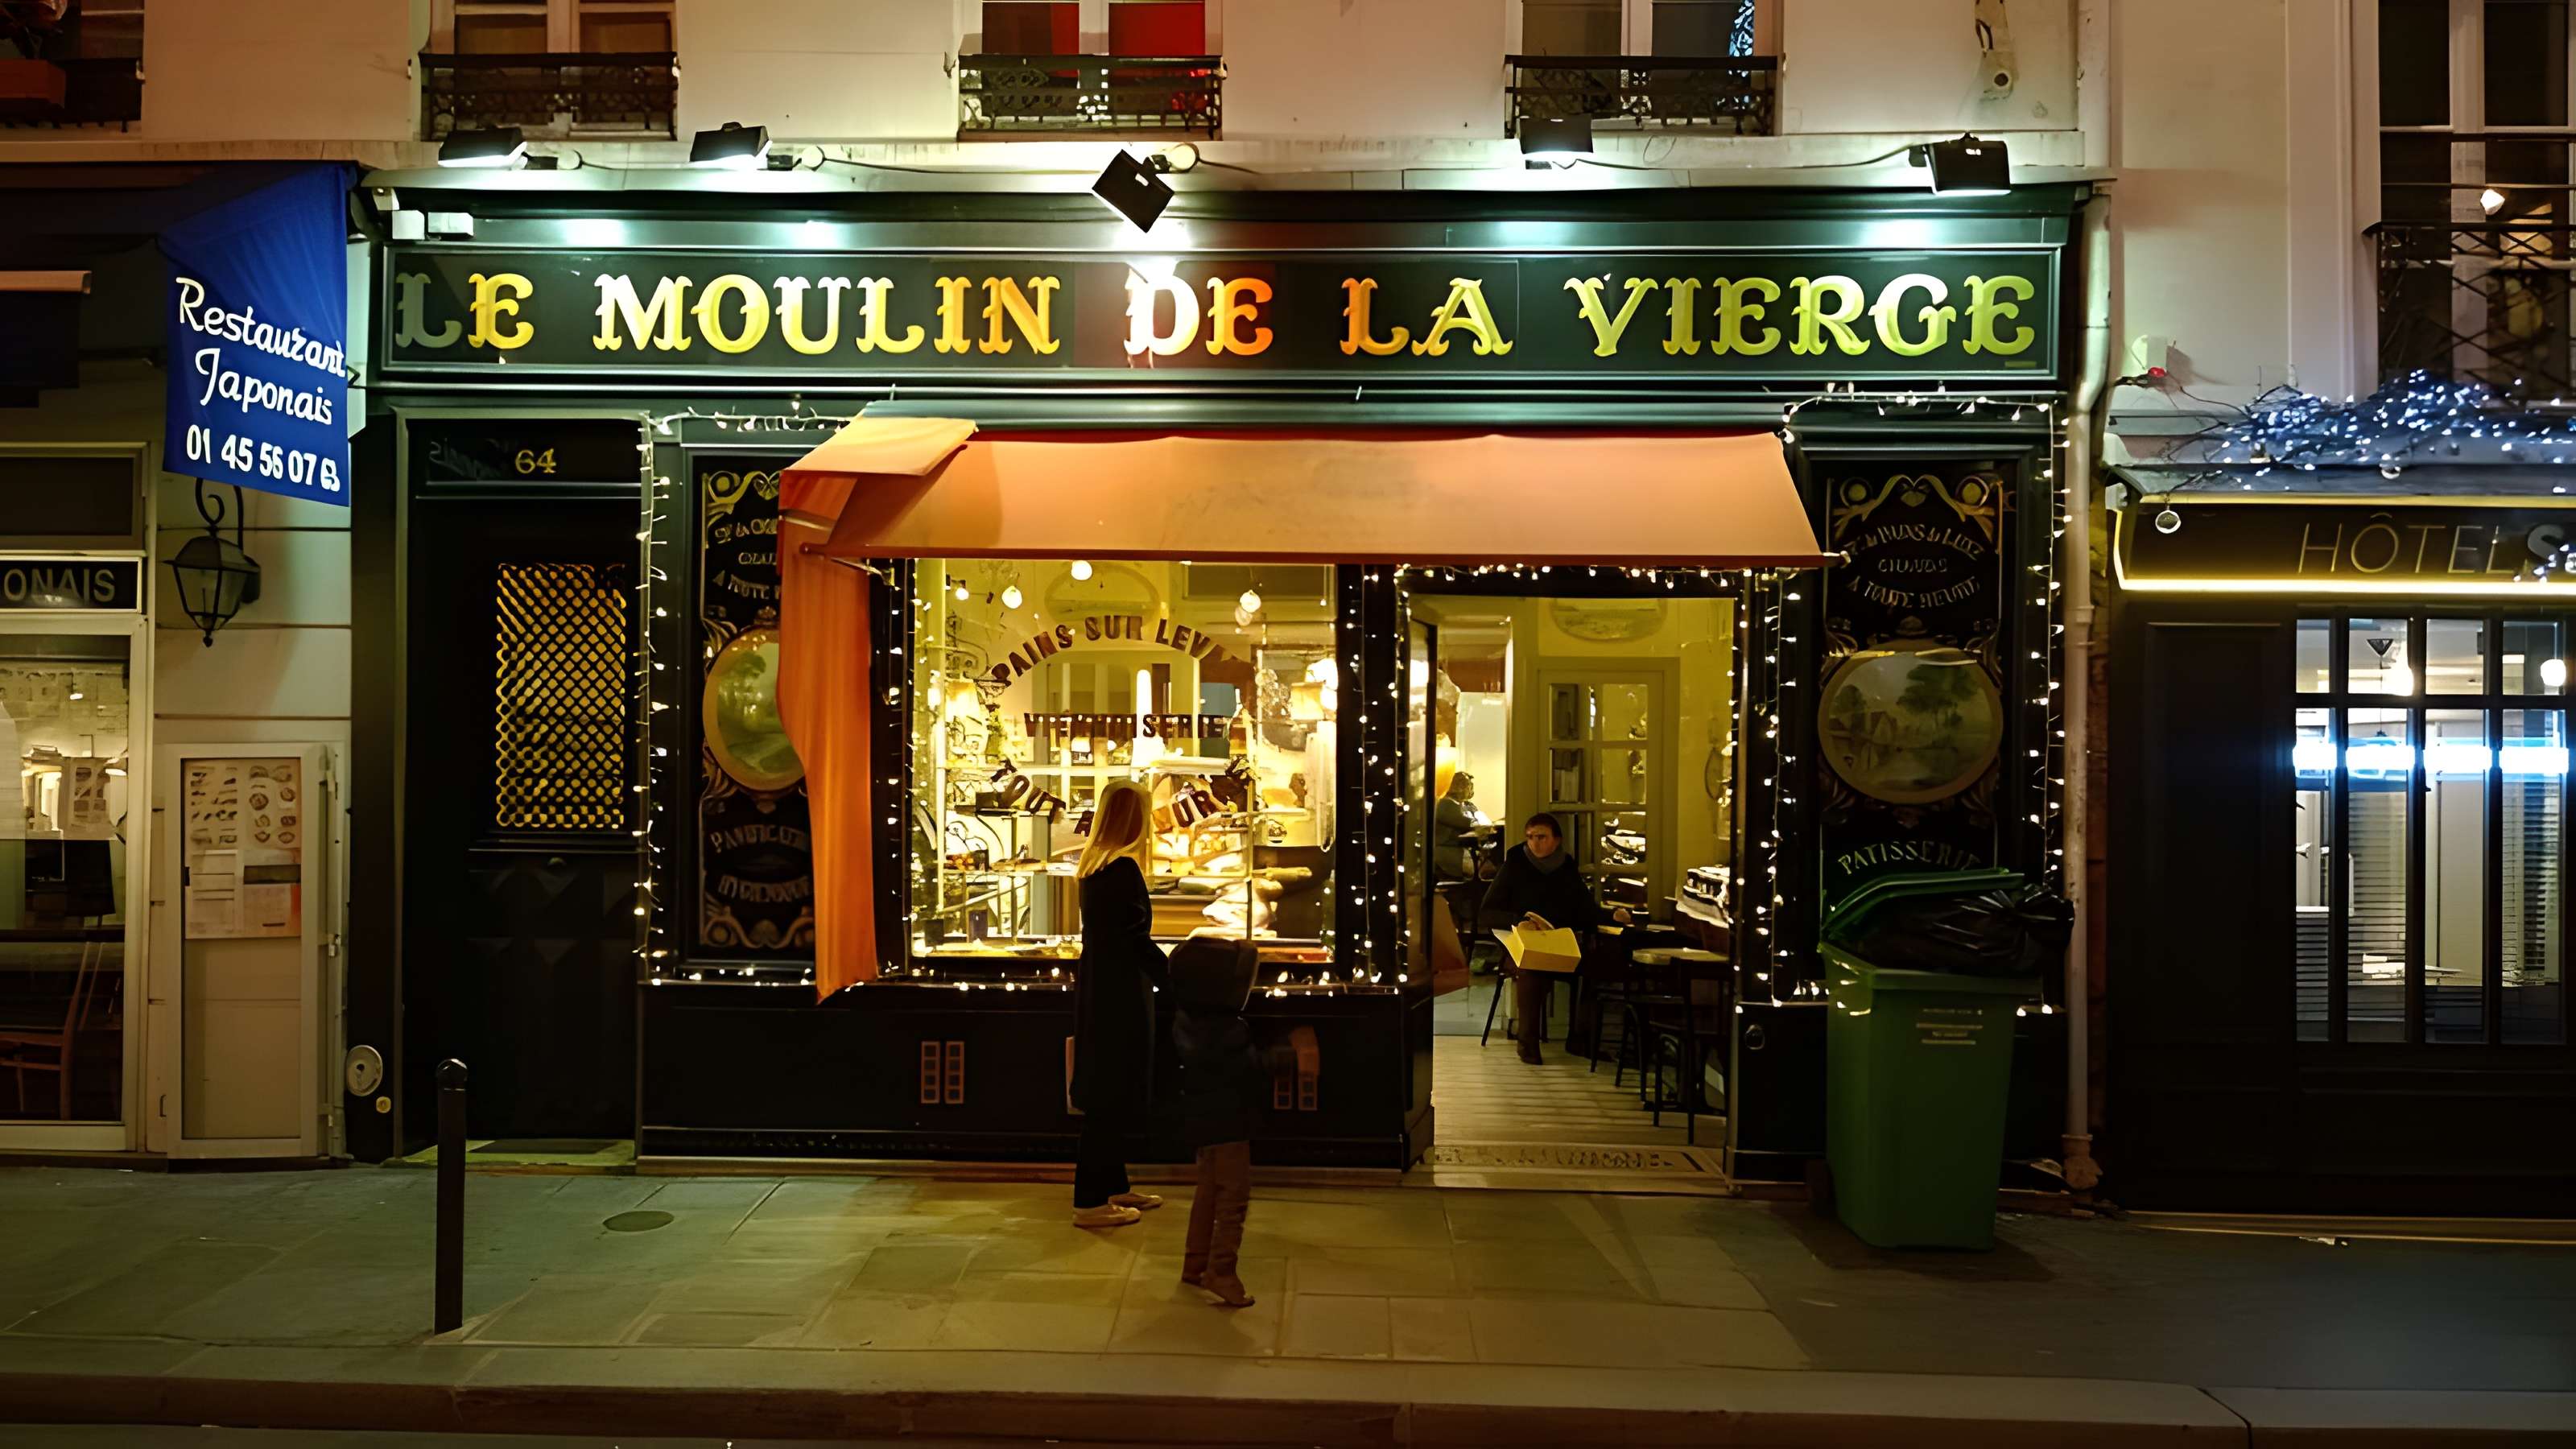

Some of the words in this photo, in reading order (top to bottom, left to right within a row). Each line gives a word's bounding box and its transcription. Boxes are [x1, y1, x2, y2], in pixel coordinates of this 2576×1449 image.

[175, 276, 345, 378] Restaurant
[395, 272, 535, 349] LE
[593, 273, 1061, 354] MOULIN
[1124, 271, 1274, 356] DE
[1340, 277, 1513, 356] LA
[1563, 273, 2035, 357] VIERGE
[195, 348, 332, 425] Japonais
[186, 424, 211, 464] 01
[221, 435, 254, 473] 45
[259, 442, 283, 480] 56
[287, 449, 317, 485] 07
[514, 448, 557, 474] 64
[3, 568, 116, 603] ONAIS
[1084, 615, 1143, 642] SUR
